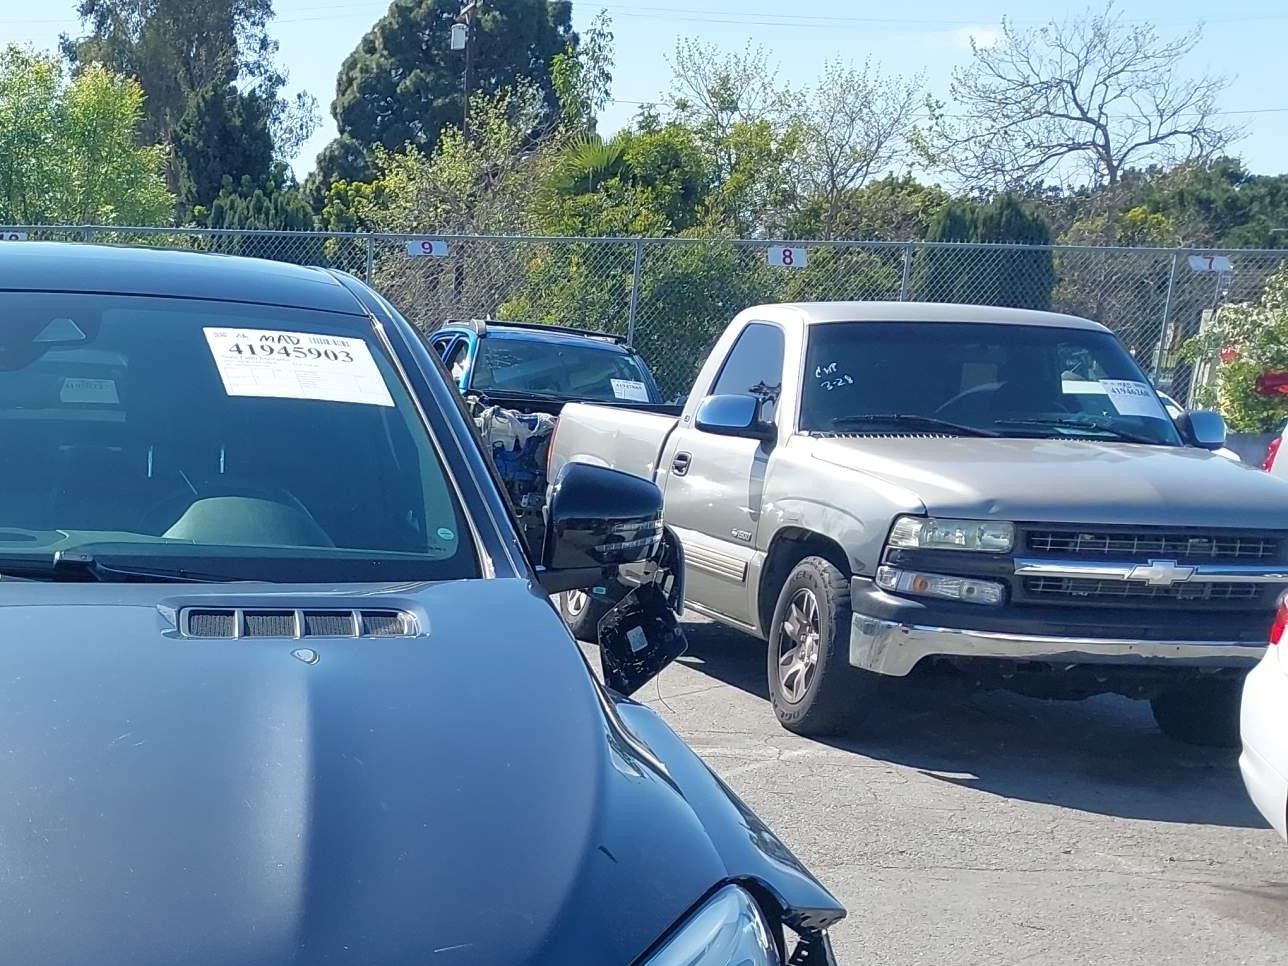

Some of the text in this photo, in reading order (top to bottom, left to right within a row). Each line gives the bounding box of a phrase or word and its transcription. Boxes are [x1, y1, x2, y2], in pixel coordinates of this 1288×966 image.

[421, 241, 433, 254] 9
[782, 249, 794, 265] 8
[1202, 257, 1215, 270] 7
[259, 334, 301, 346] MAD
[229, 342, 354, 364] 41945903
